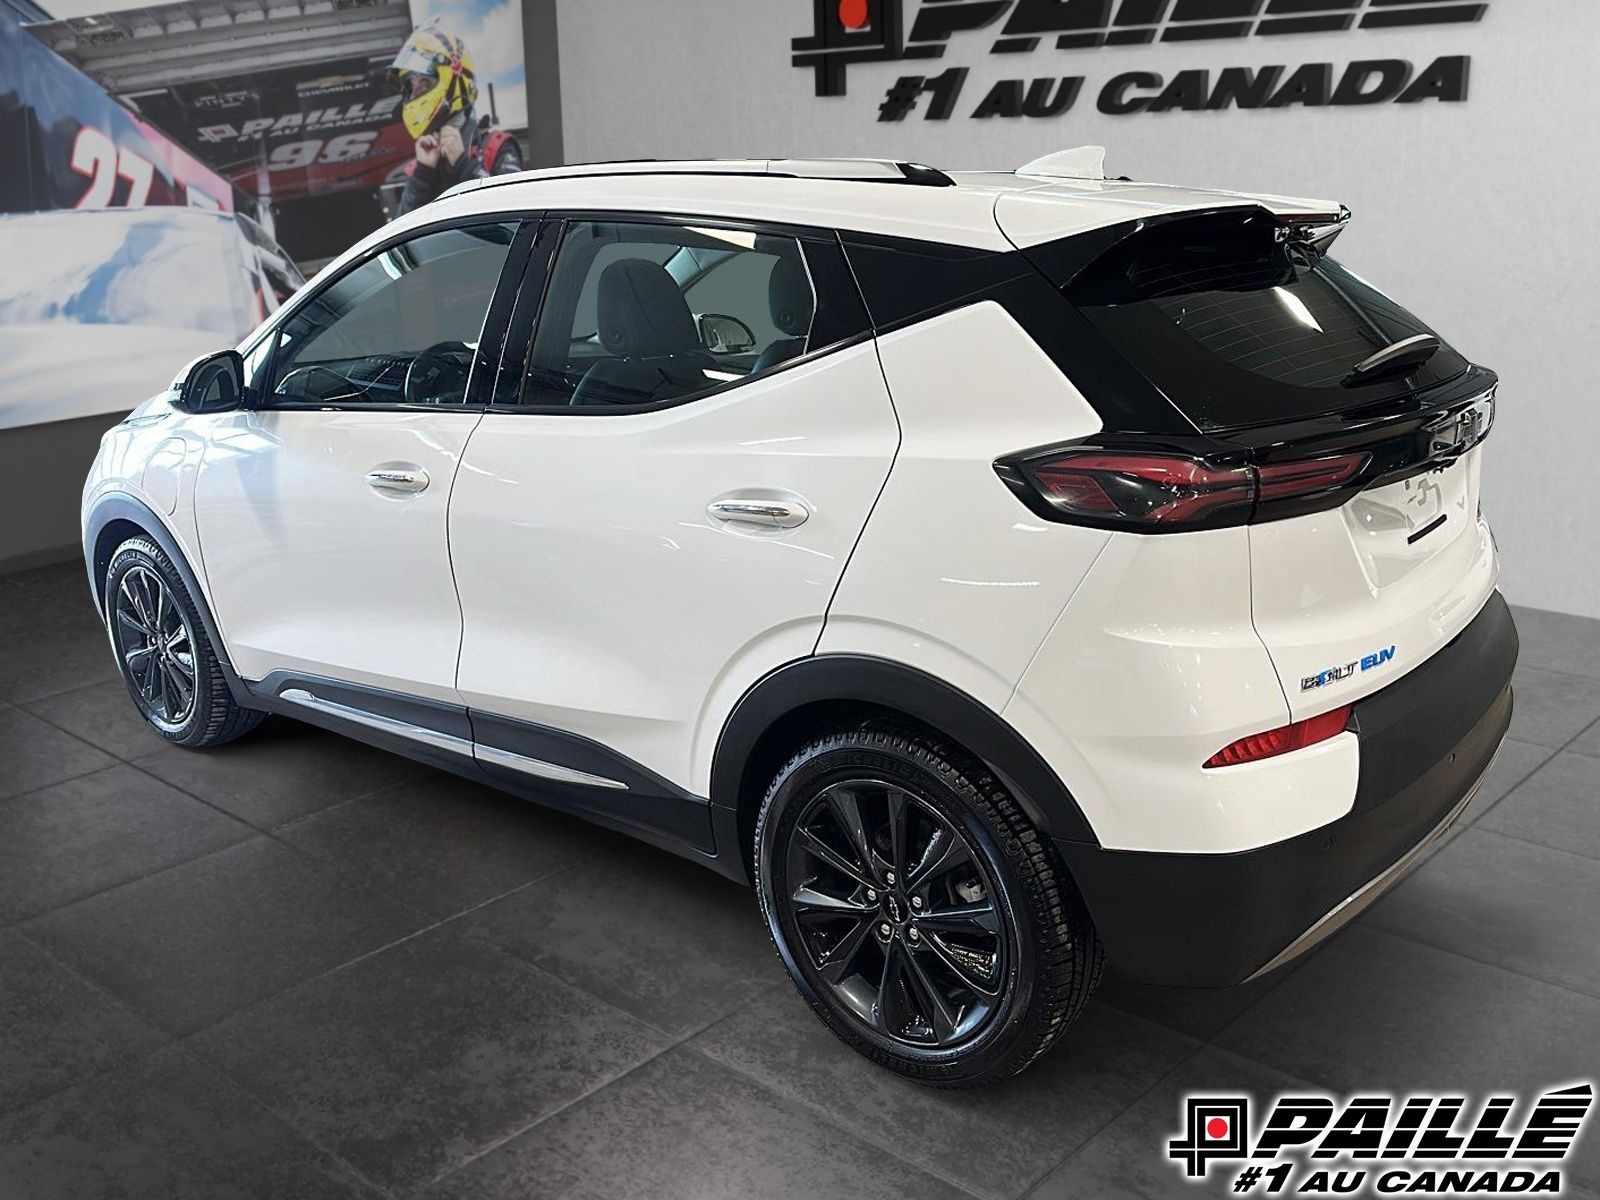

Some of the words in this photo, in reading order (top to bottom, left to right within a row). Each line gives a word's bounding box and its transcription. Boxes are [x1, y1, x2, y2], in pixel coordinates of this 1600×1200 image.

[877, 66, 970, 122] #1
[969, 75, 1086, 119] AU
[1096, 54, 1472, 117] CANADA
[269, 126, 300, 138] AU
[306, 113, 393, 132] CANADA
[72, 124, 154, 210] 27
[265, 131, 379, 170] 96
[1301, 661, 1359, 691] BOLT
[1360, 645, 1396, 672] EUV
